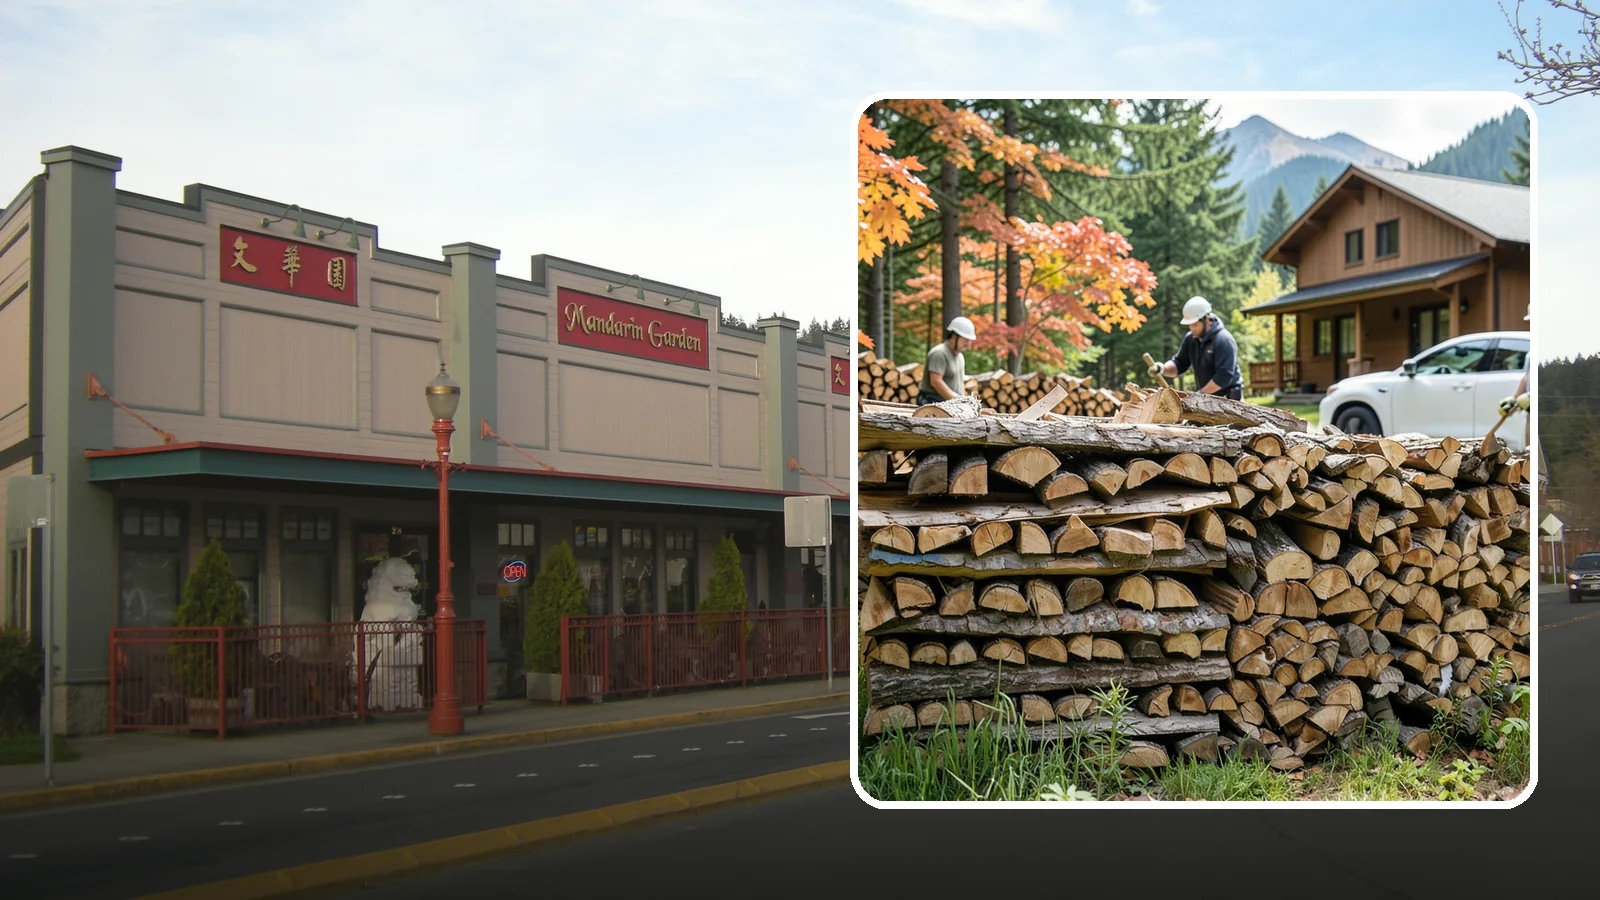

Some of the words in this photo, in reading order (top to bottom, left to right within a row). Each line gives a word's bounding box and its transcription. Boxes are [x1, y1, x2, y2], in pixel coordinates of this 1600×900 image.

[230, 236, 346, 291] 文華園
[564, 302, 644, 341] Mandarin
[647, 320, 702, 352] Garden
[503, 565, 527, 578] OPEN
